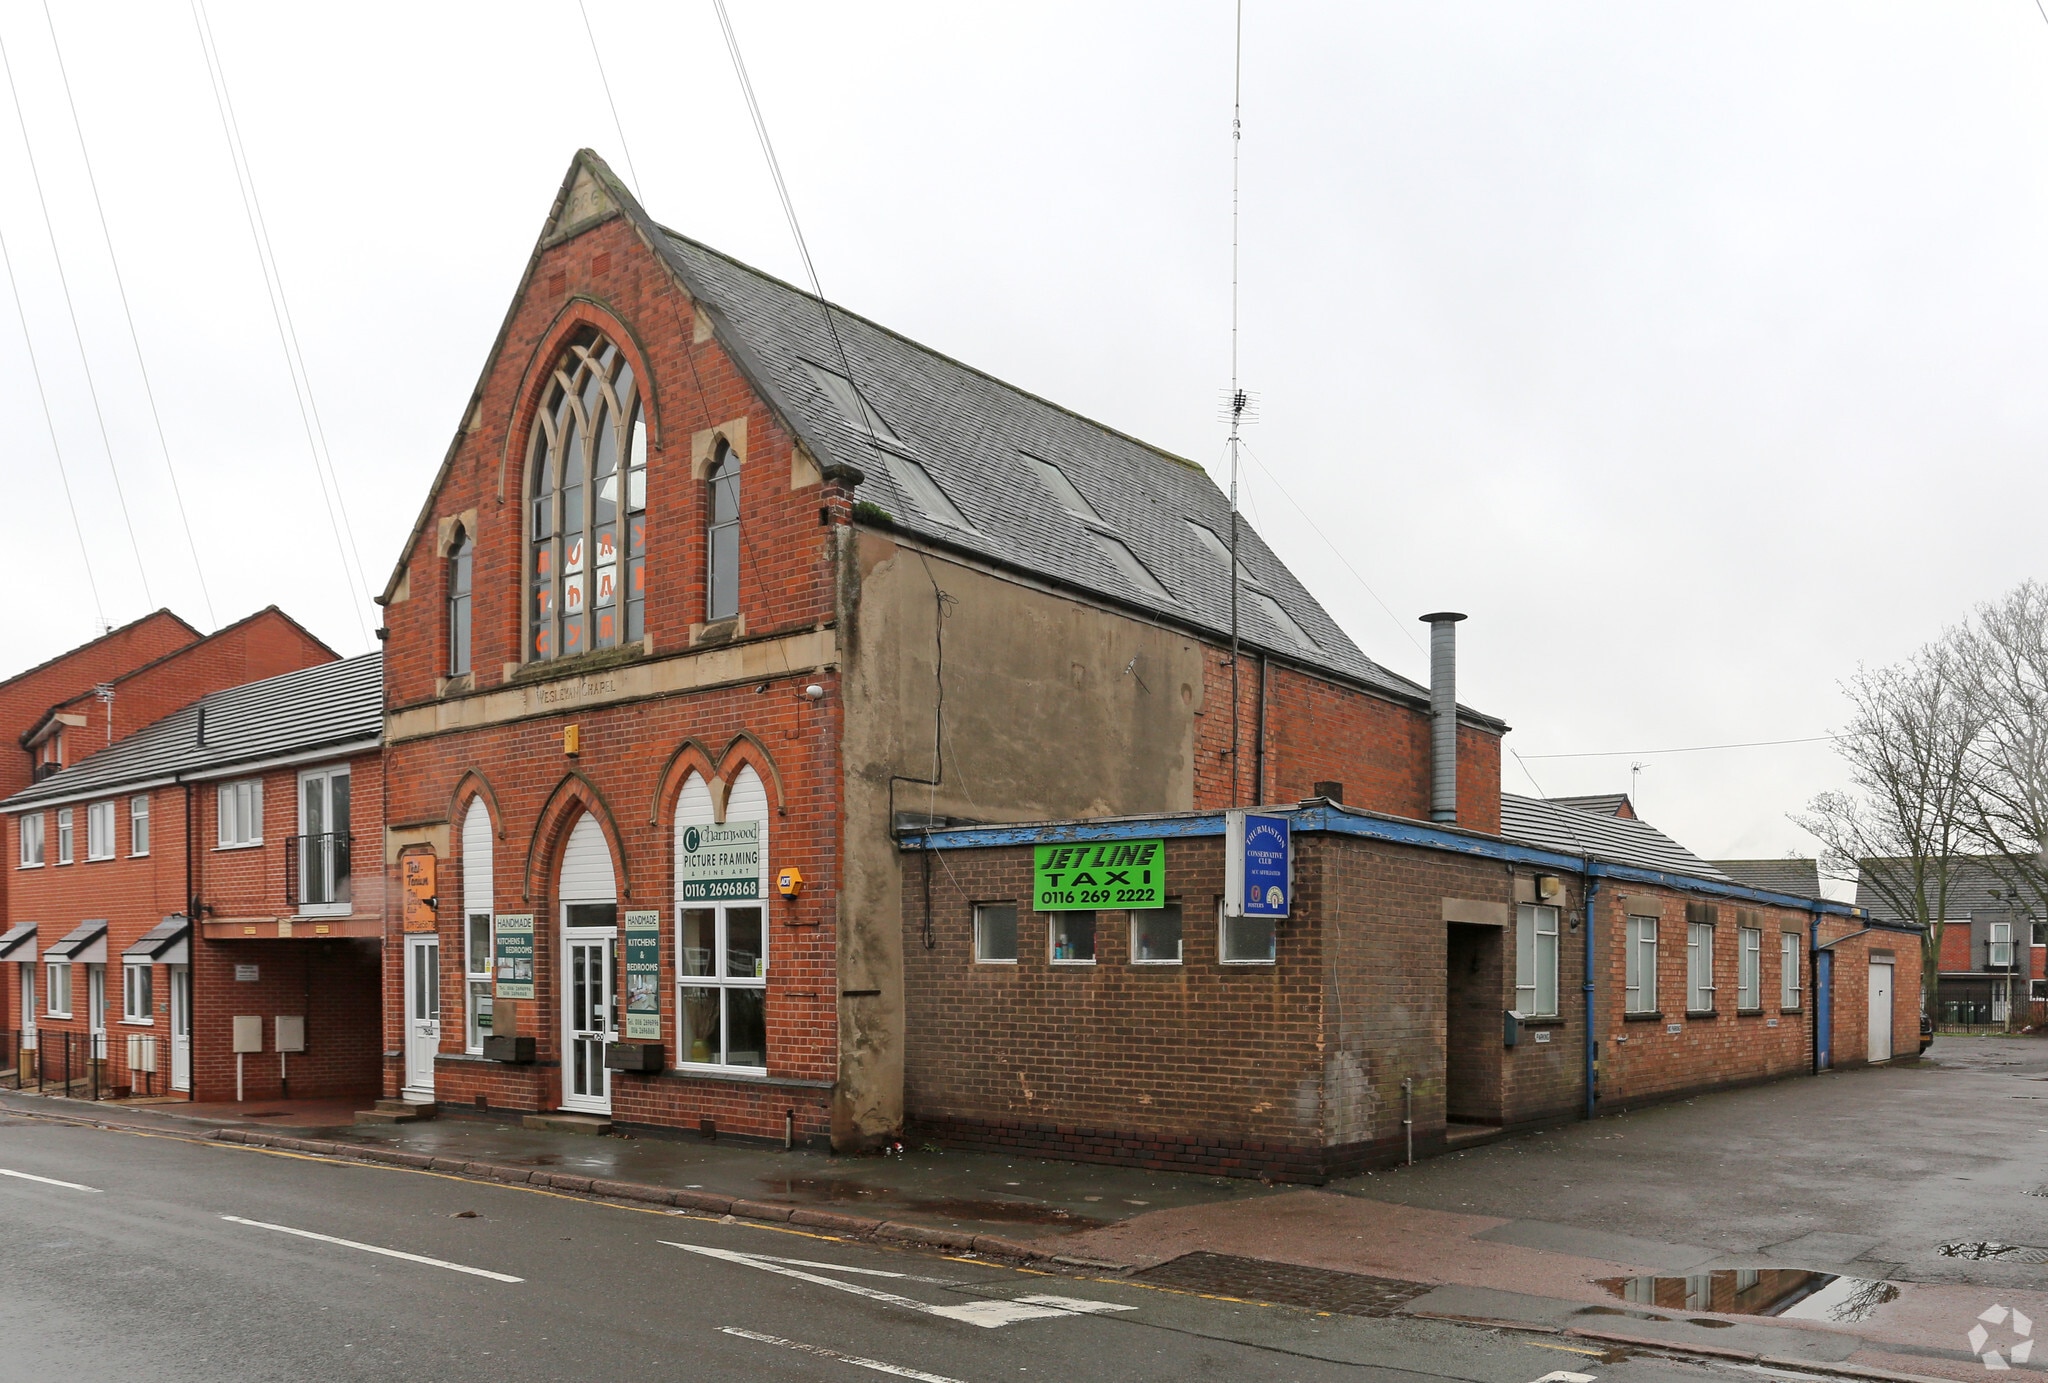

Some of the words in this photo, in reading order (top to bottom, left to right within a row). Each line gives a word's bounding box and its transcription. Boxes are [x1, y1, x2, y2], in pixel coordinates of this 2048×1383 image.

[536, 686, 579, 704] WESLEYAN
[582, 680, 616, 696] CHAPEL
[1245, 825, 1286, 848] THURMASTON
[684, 853, 716, 868] PICTURE
[719, 851, 757, 866] FRAMING
[1040, 848, 1091, 870] JET
[1090, 844, 1158, 868] LINE
[1247, 850, 1283, 859] CONSERVATIVE
[1044, 870, 1151, 887] TAXI
[685, 883, 706, 897] 0116
[709, 881, 756, 897] 2696868
[1041, 891, 1075, 904] 0116
[1080, 890, 1111, 903] 269
[1116, 888, 1155, 902] 2222
[497, 918, 531, 928] HANDMADE
[627, 915, 656, 925] HANDMADE
[497, 937, 520, 945] KITCHENS
[628, 938, 656, 947] KITCHENS
[505, 946, 533, 954] BEDROOMS
[639, 950, 645, 959] &
[626, 963, 658, 972] BEDROOMS
